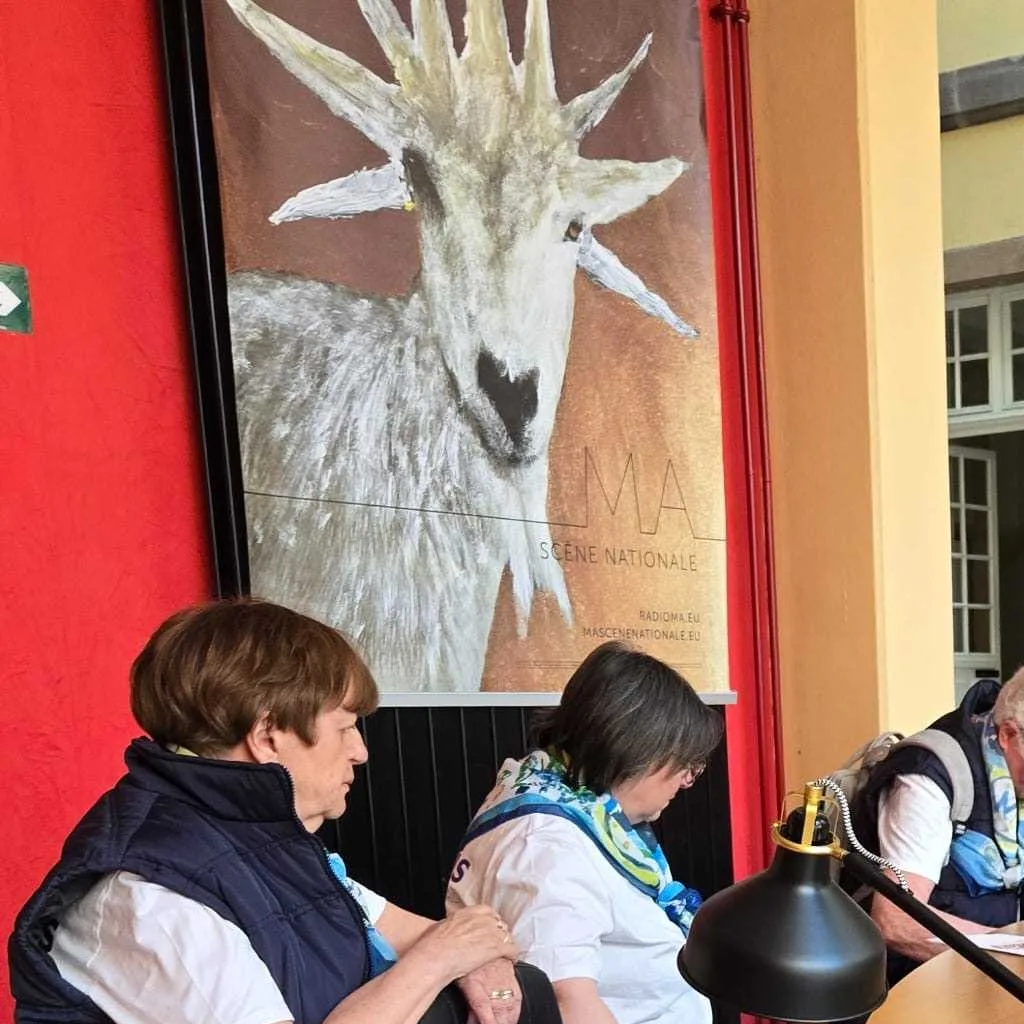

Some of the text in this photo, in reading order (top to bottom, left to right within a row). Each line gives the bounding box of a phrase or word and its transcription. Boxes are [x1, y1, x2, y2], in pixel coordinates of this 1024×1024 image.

[584, 446, 696, 537] MA
[604, 547, 698, 572] NATIONALE
[639, 610, 701, 625] RADIOMA.EU
